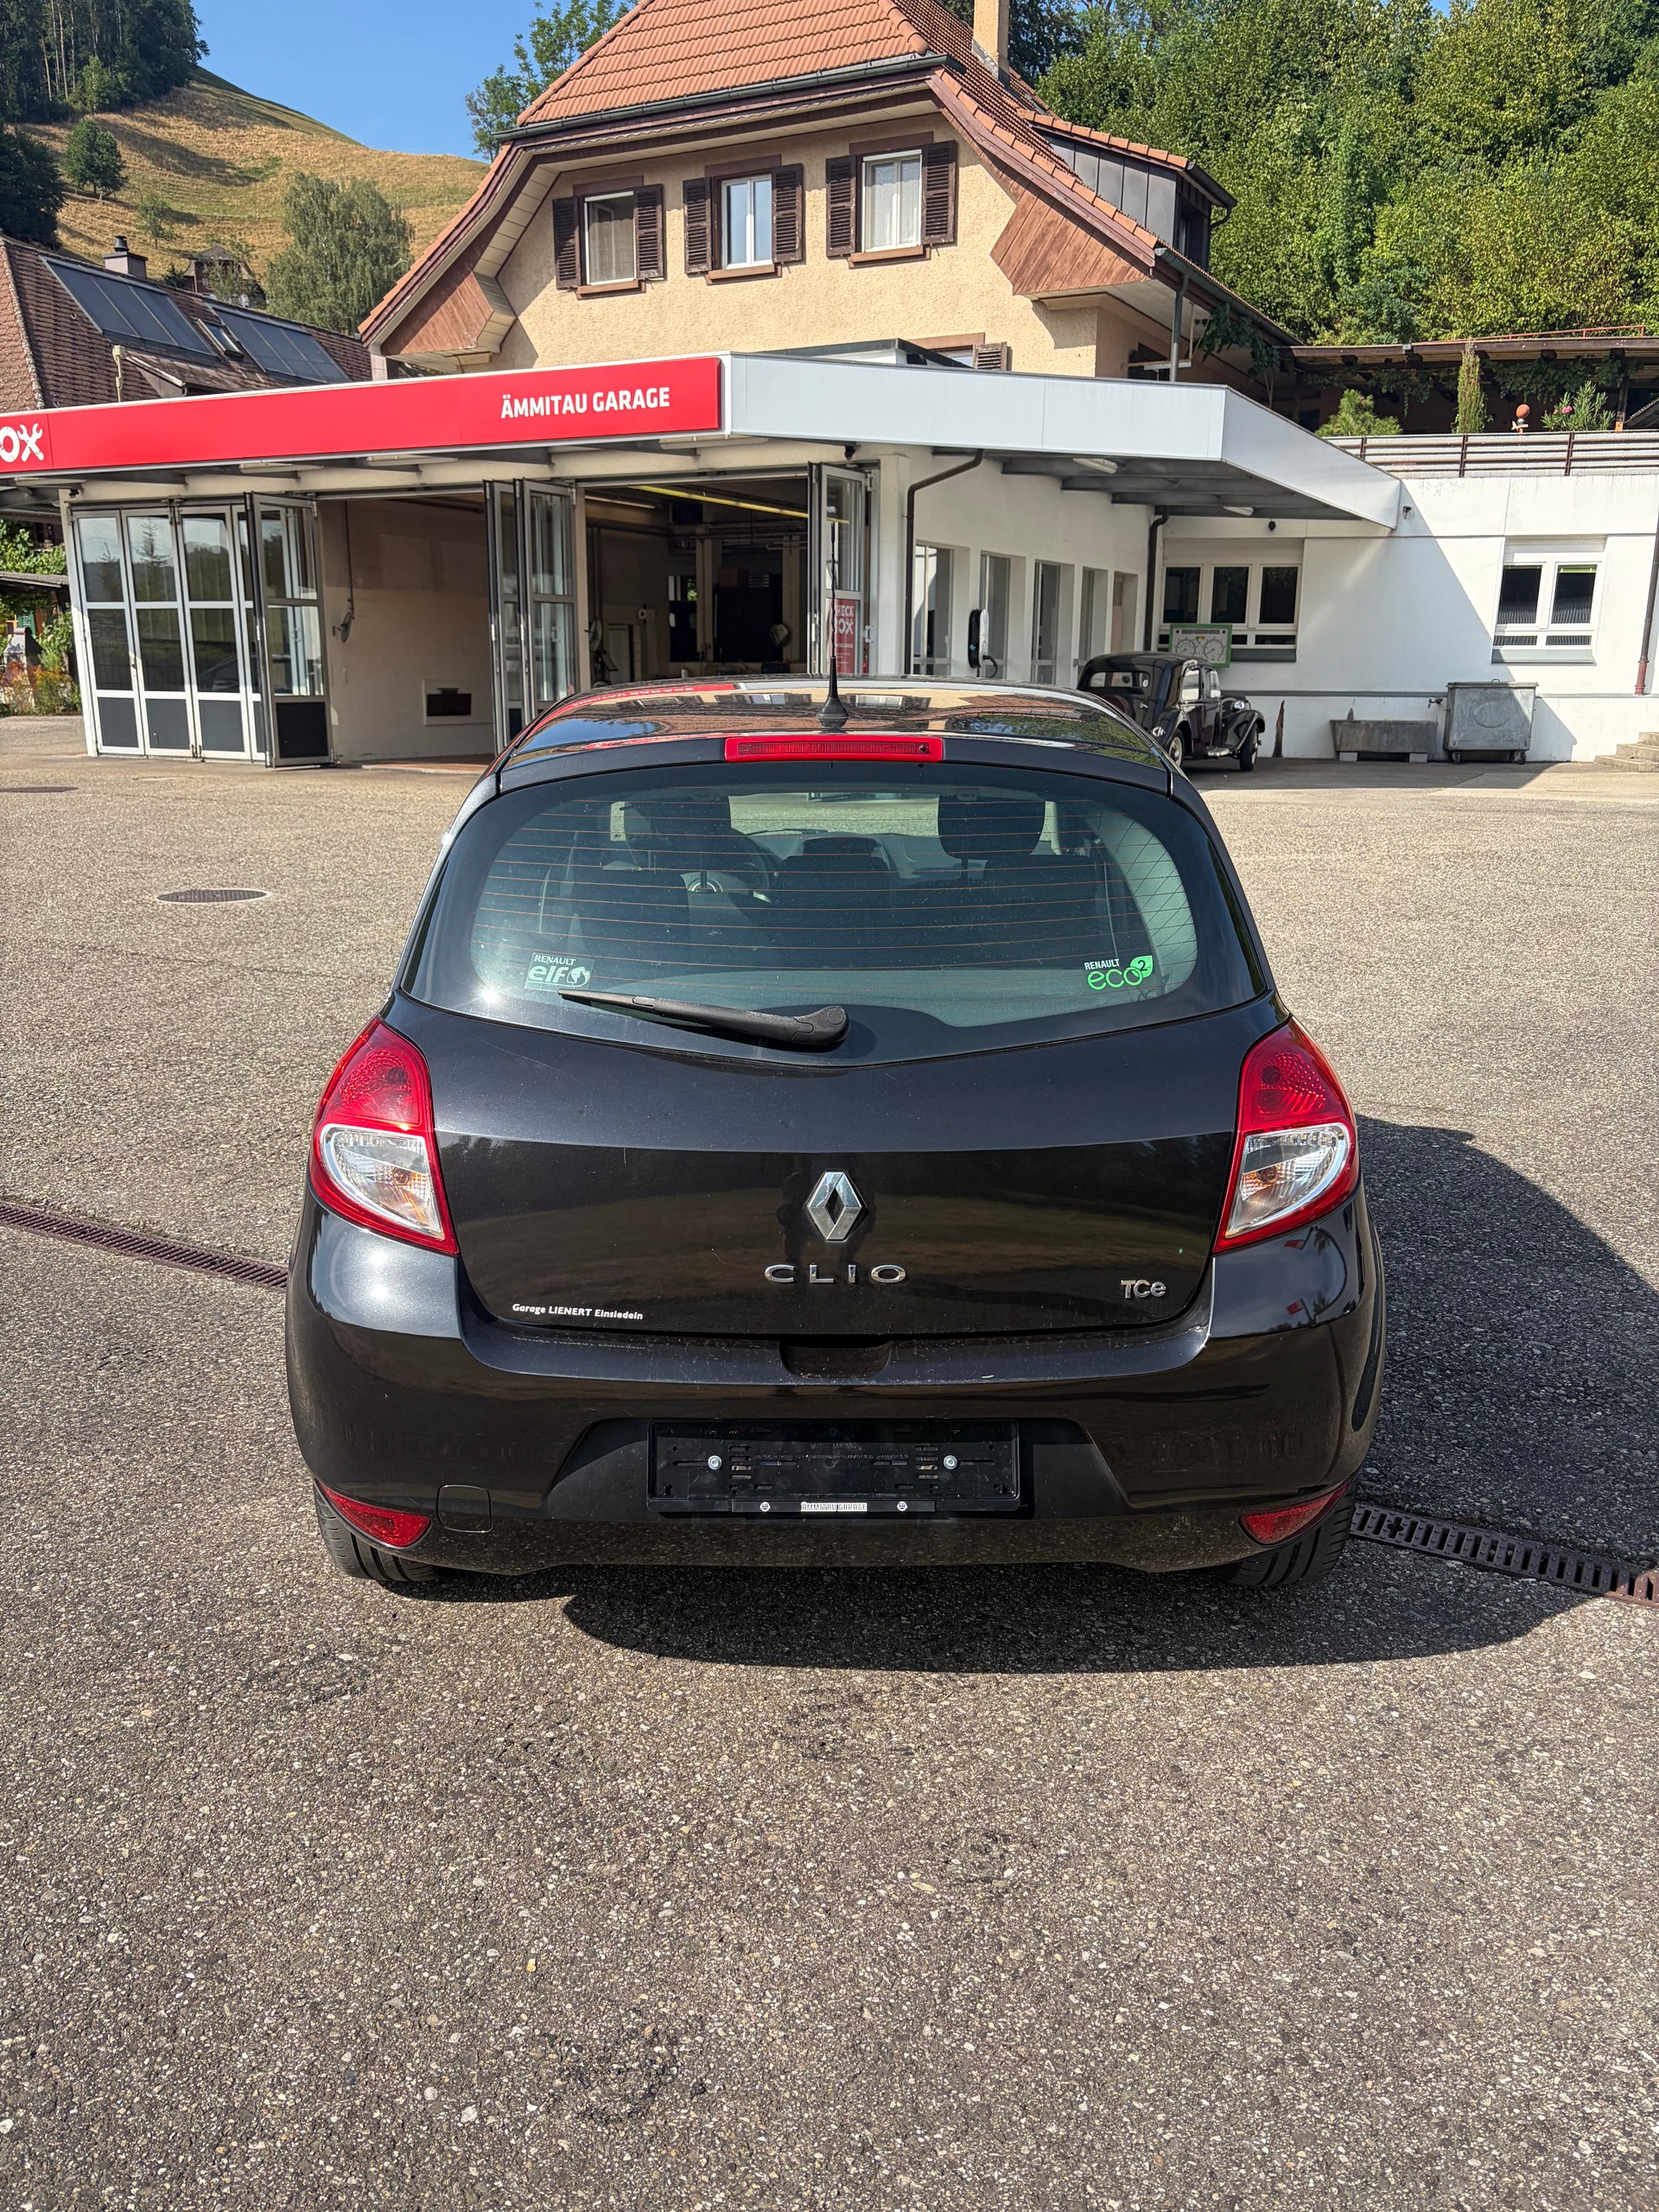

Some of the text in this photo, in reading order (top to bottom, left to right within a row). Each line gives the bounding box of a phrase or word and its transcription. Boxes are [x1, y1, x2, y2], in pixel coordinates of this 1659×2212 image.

[500, 387, 671, 419] ÄMMITAU GARAGE
[833, 605, 855, 618] HECK
[534, 955, 576, 966] RENAULT
[1084, 958, 1120, 970] RENAULT
[528, 965, 569, 983] elf
[764, 1264, 906, 1283] CLIO
[1121, 1279, 1166, 1299] TCe
[512, 1303, 545, 1315] Garage
[549, 1306, 592, 1317] LIENERT
[837, 1503, 868, 1512] GARAGE
